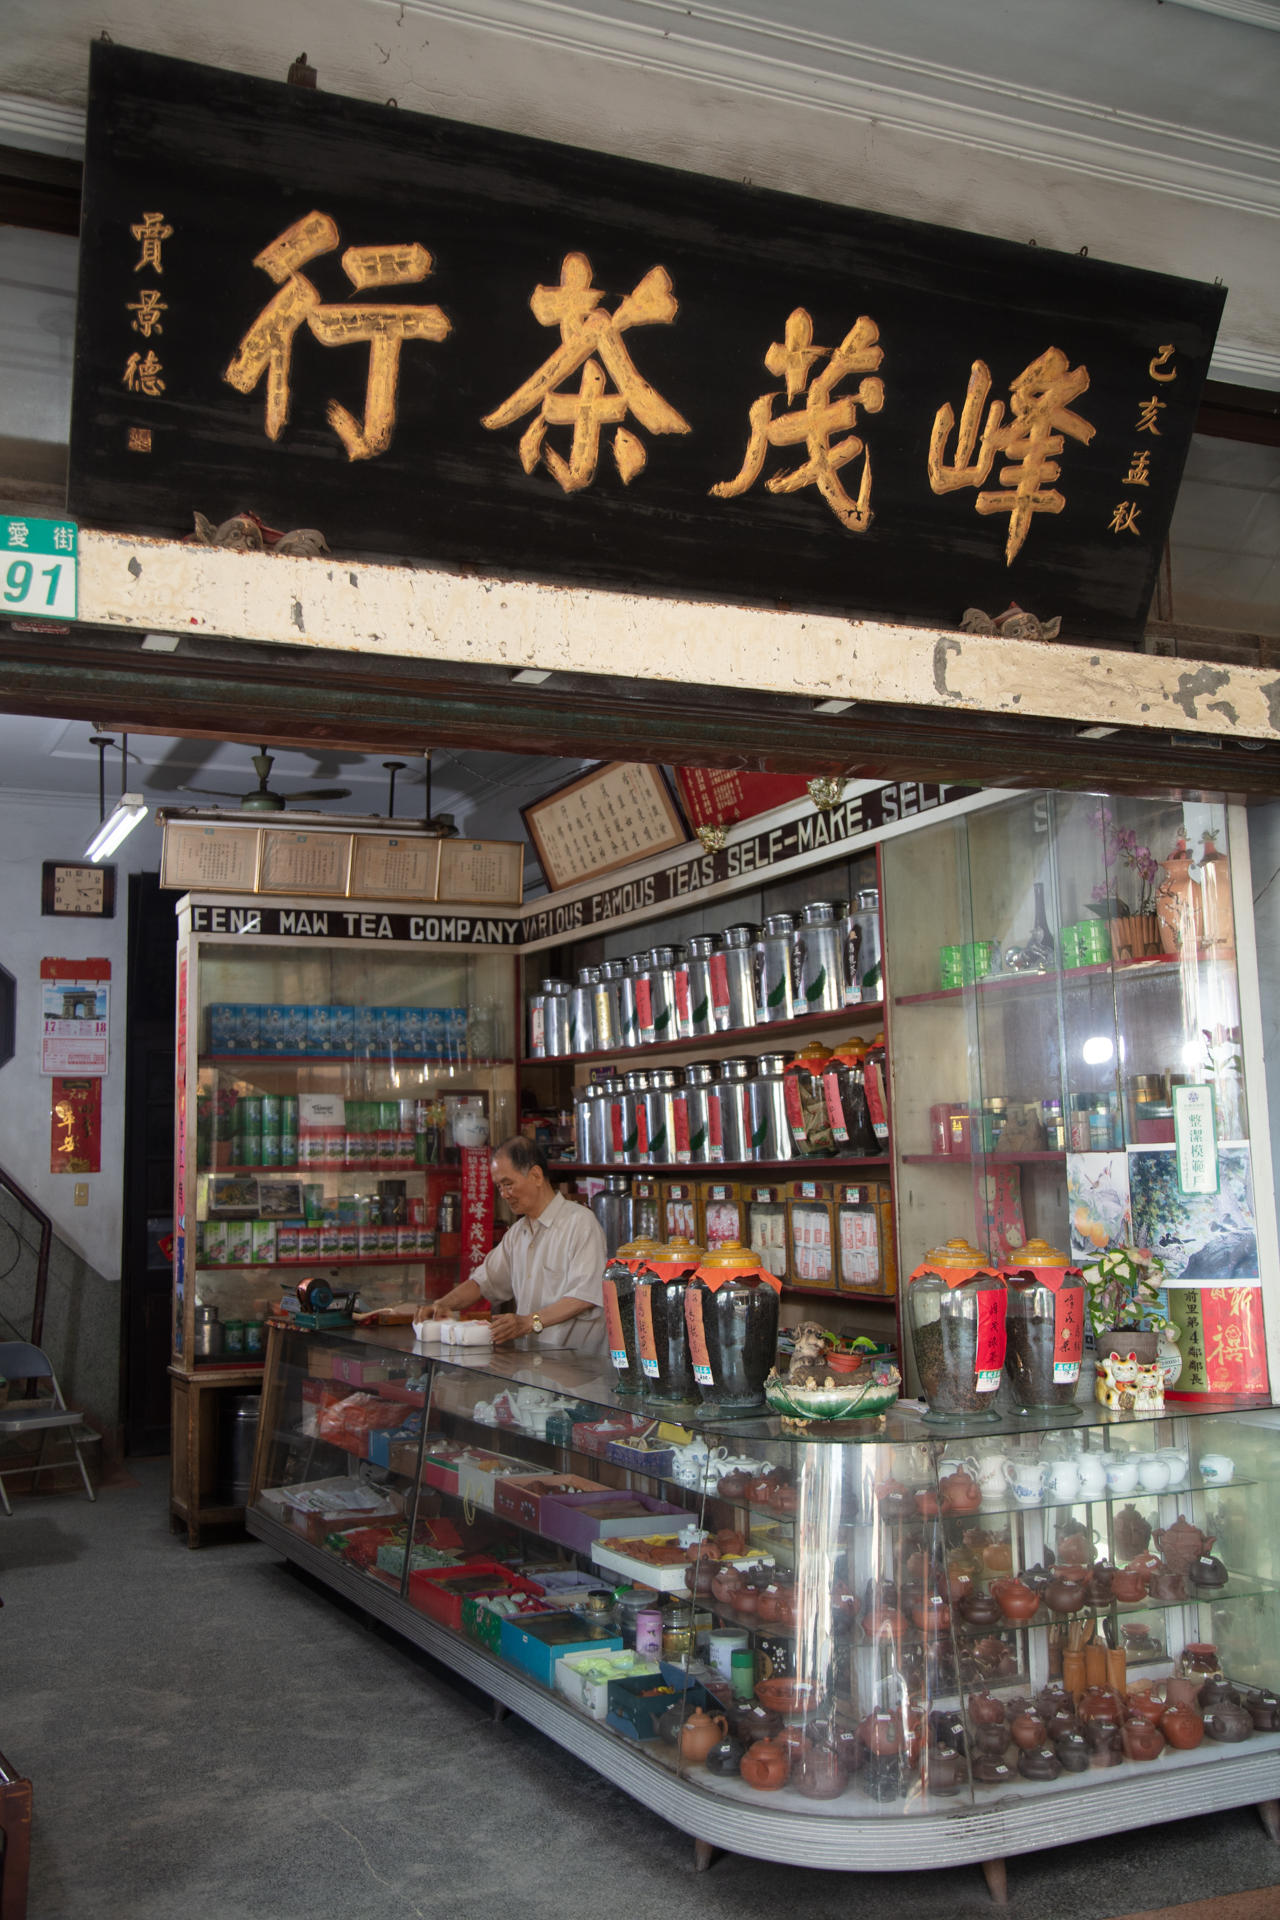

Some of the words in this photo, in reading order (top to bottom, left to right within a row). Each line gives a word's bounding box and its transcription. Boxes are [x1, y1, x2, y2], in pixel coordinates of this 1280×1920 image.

[3, 560, 63, 606] 91
[194, 908, 261, 933] FENG
[279, 911, 328, 935] MAW
[343, 913, 393, 938] TEA
[410, 916, 519, 944] COMPANY
[522, 902, 583, 942] VARIOUS
[592, 876, 655, 922] FAMOUS
[1188, 1114, 1205, 1188] 整潔模範戶
[1184, 1288, 1204, 1386] 前里第4鄰鄰長
